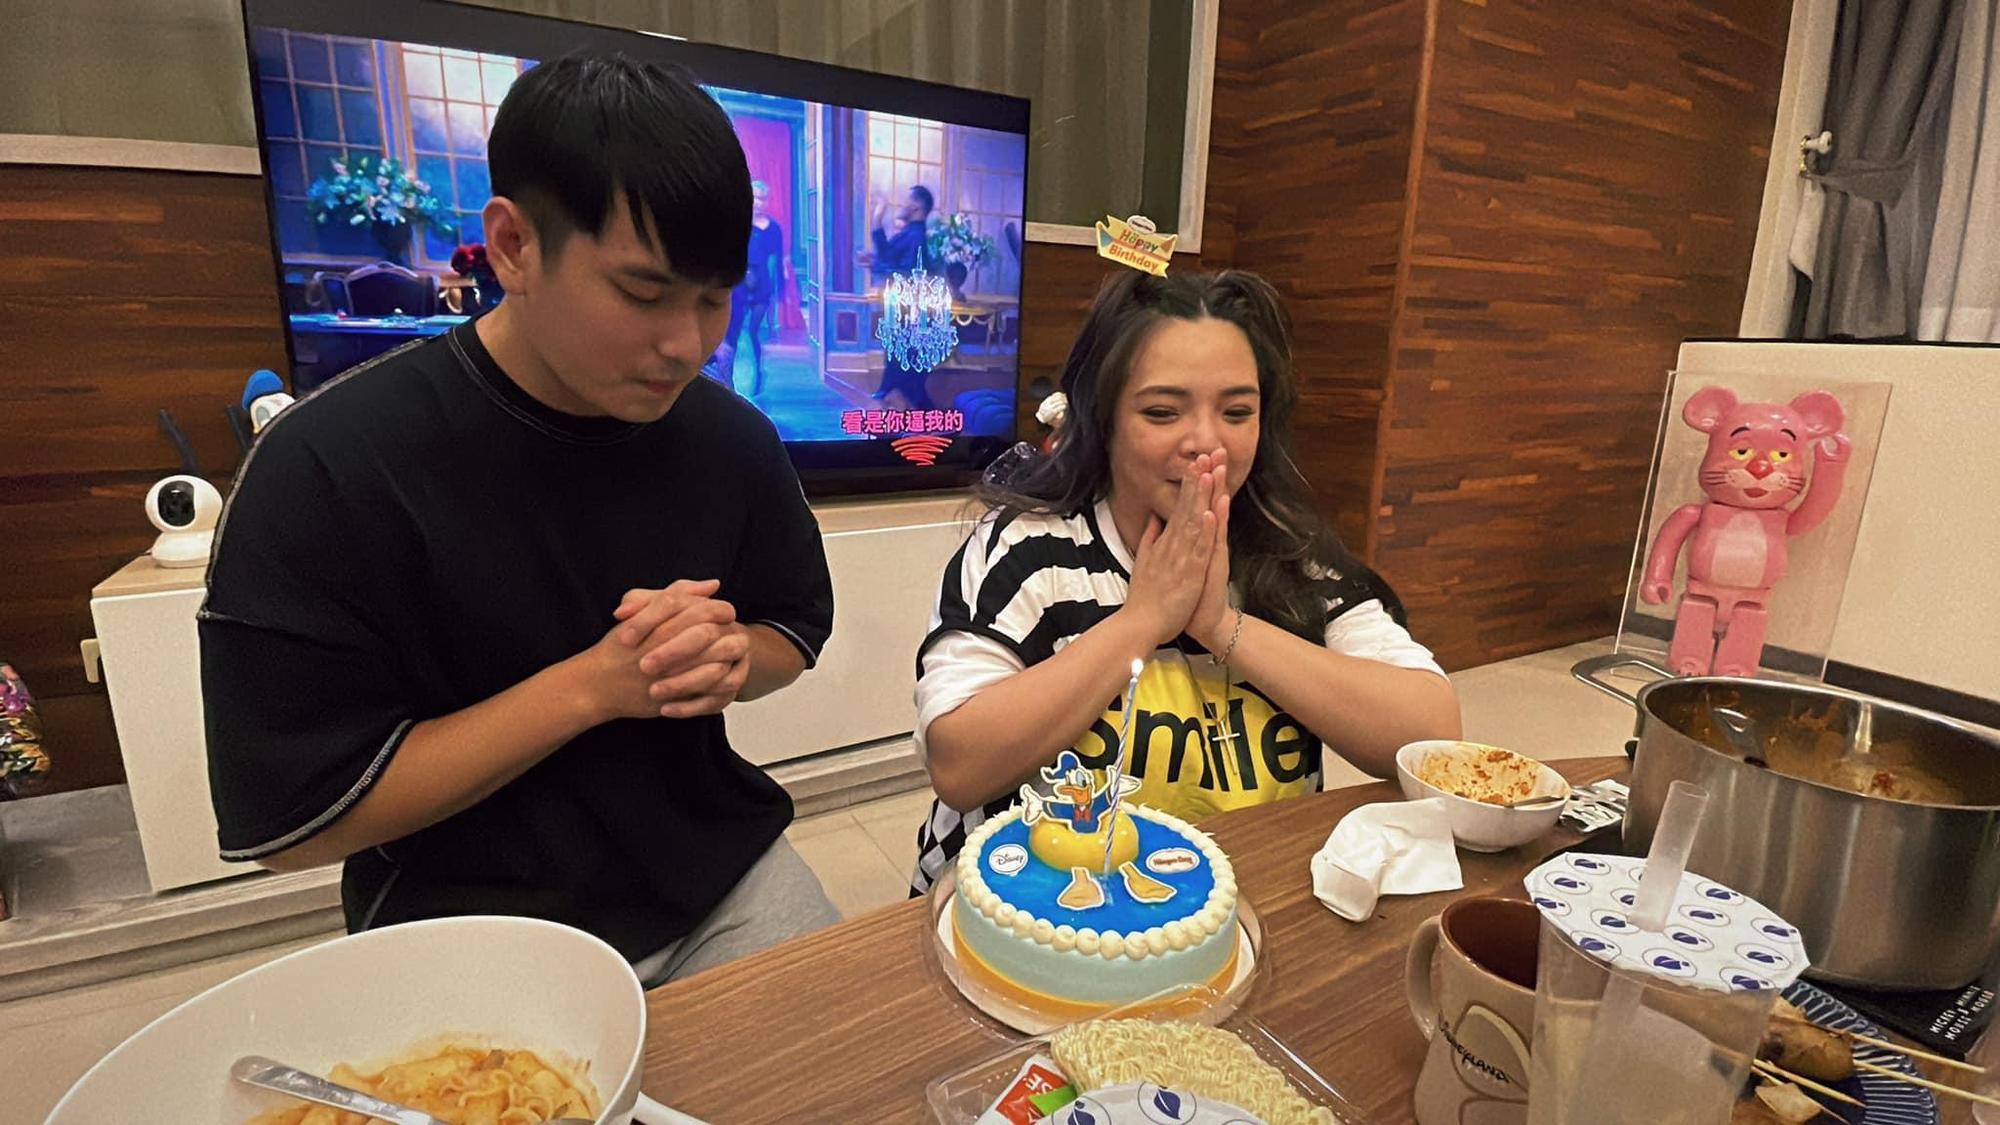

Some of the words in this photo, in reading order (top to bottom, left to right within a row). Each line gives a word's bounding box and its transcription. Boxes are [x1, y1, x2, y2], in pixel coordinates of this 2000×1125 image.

[1120, 229, 1159, 253] Happy
[1109, 244, 1158, 272] Birthday
[842, 409, 964, 433] 看是你逼我的
